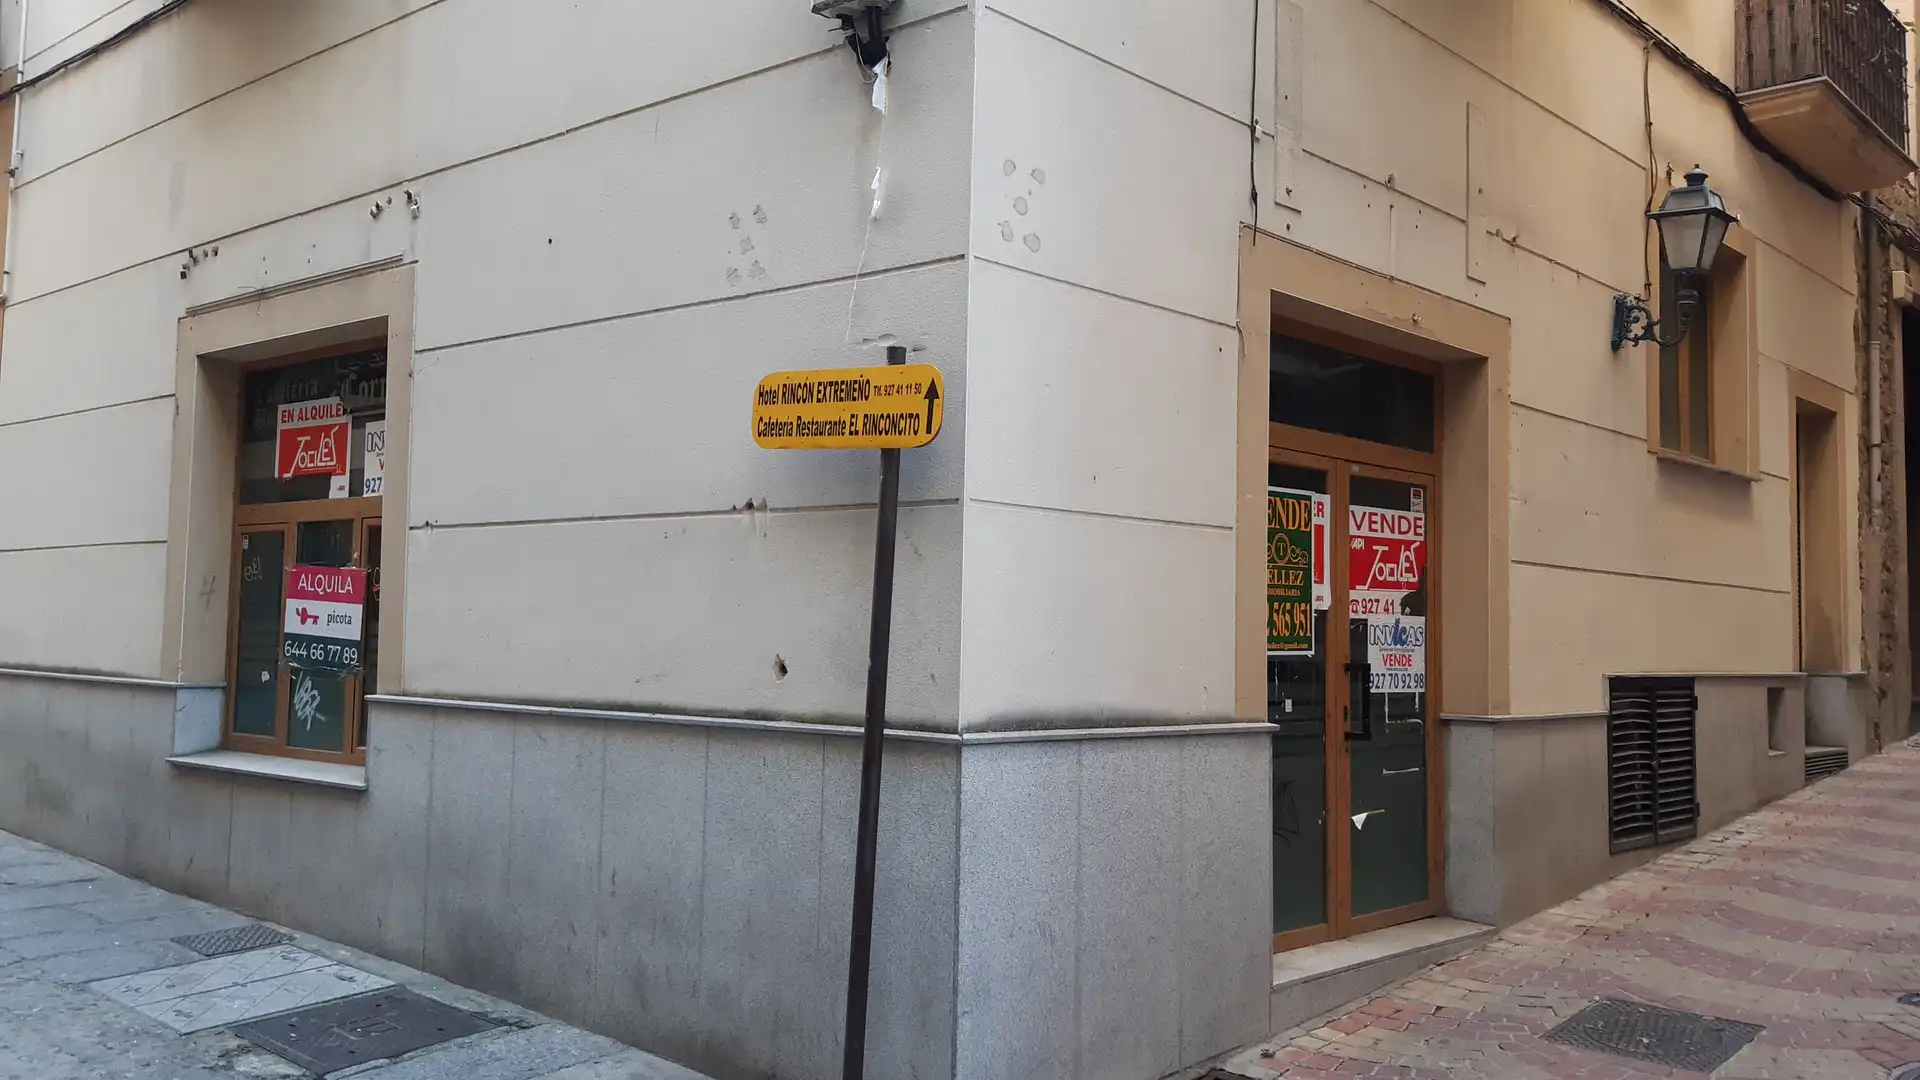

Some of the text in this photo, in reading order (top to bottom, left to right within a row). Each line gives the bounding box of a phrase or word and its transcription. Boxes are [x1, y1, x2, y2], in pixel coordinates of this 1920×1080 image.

[758, 384, 779, 406] Hotel
[781, 377, 814, 404] RINCÓN
[816, 375, 870, 403] EXTREMEÑO
[884, 383, 895, 396] 927
[896, 383, 903, 395] 41
[905, 382, 912, 395] 11
[914, 382, 922, 395] 50
[281, 408, 294, 424] EN
[757, 413, 920, 438] Cafetería Restaurante EL RINCONCITO
[367, 430, 385, 452] IN
[365, 477, 382, 494] 927
[1267, 496, 1311, 531] ENDE
[1350, 510, 1423, 537] VENDE
[1351, 538, 1364, 550] API
[298, 574, 353, 595] ALQUILA
[1267, 565, 1305, 586] ÉLLEZ
[1361, 598, 1395, 615] 927 41
[326, 609, 352, 626] picota
[1273, 602, 1290, 636] 565
[1294, 602, 1311, 636] 951
[284, 640, 358, 664] 644 66 77 89
[1381, 653, 1412, 667] VENDE
[1369, 672, 1424, 689] 927 70 92 98
